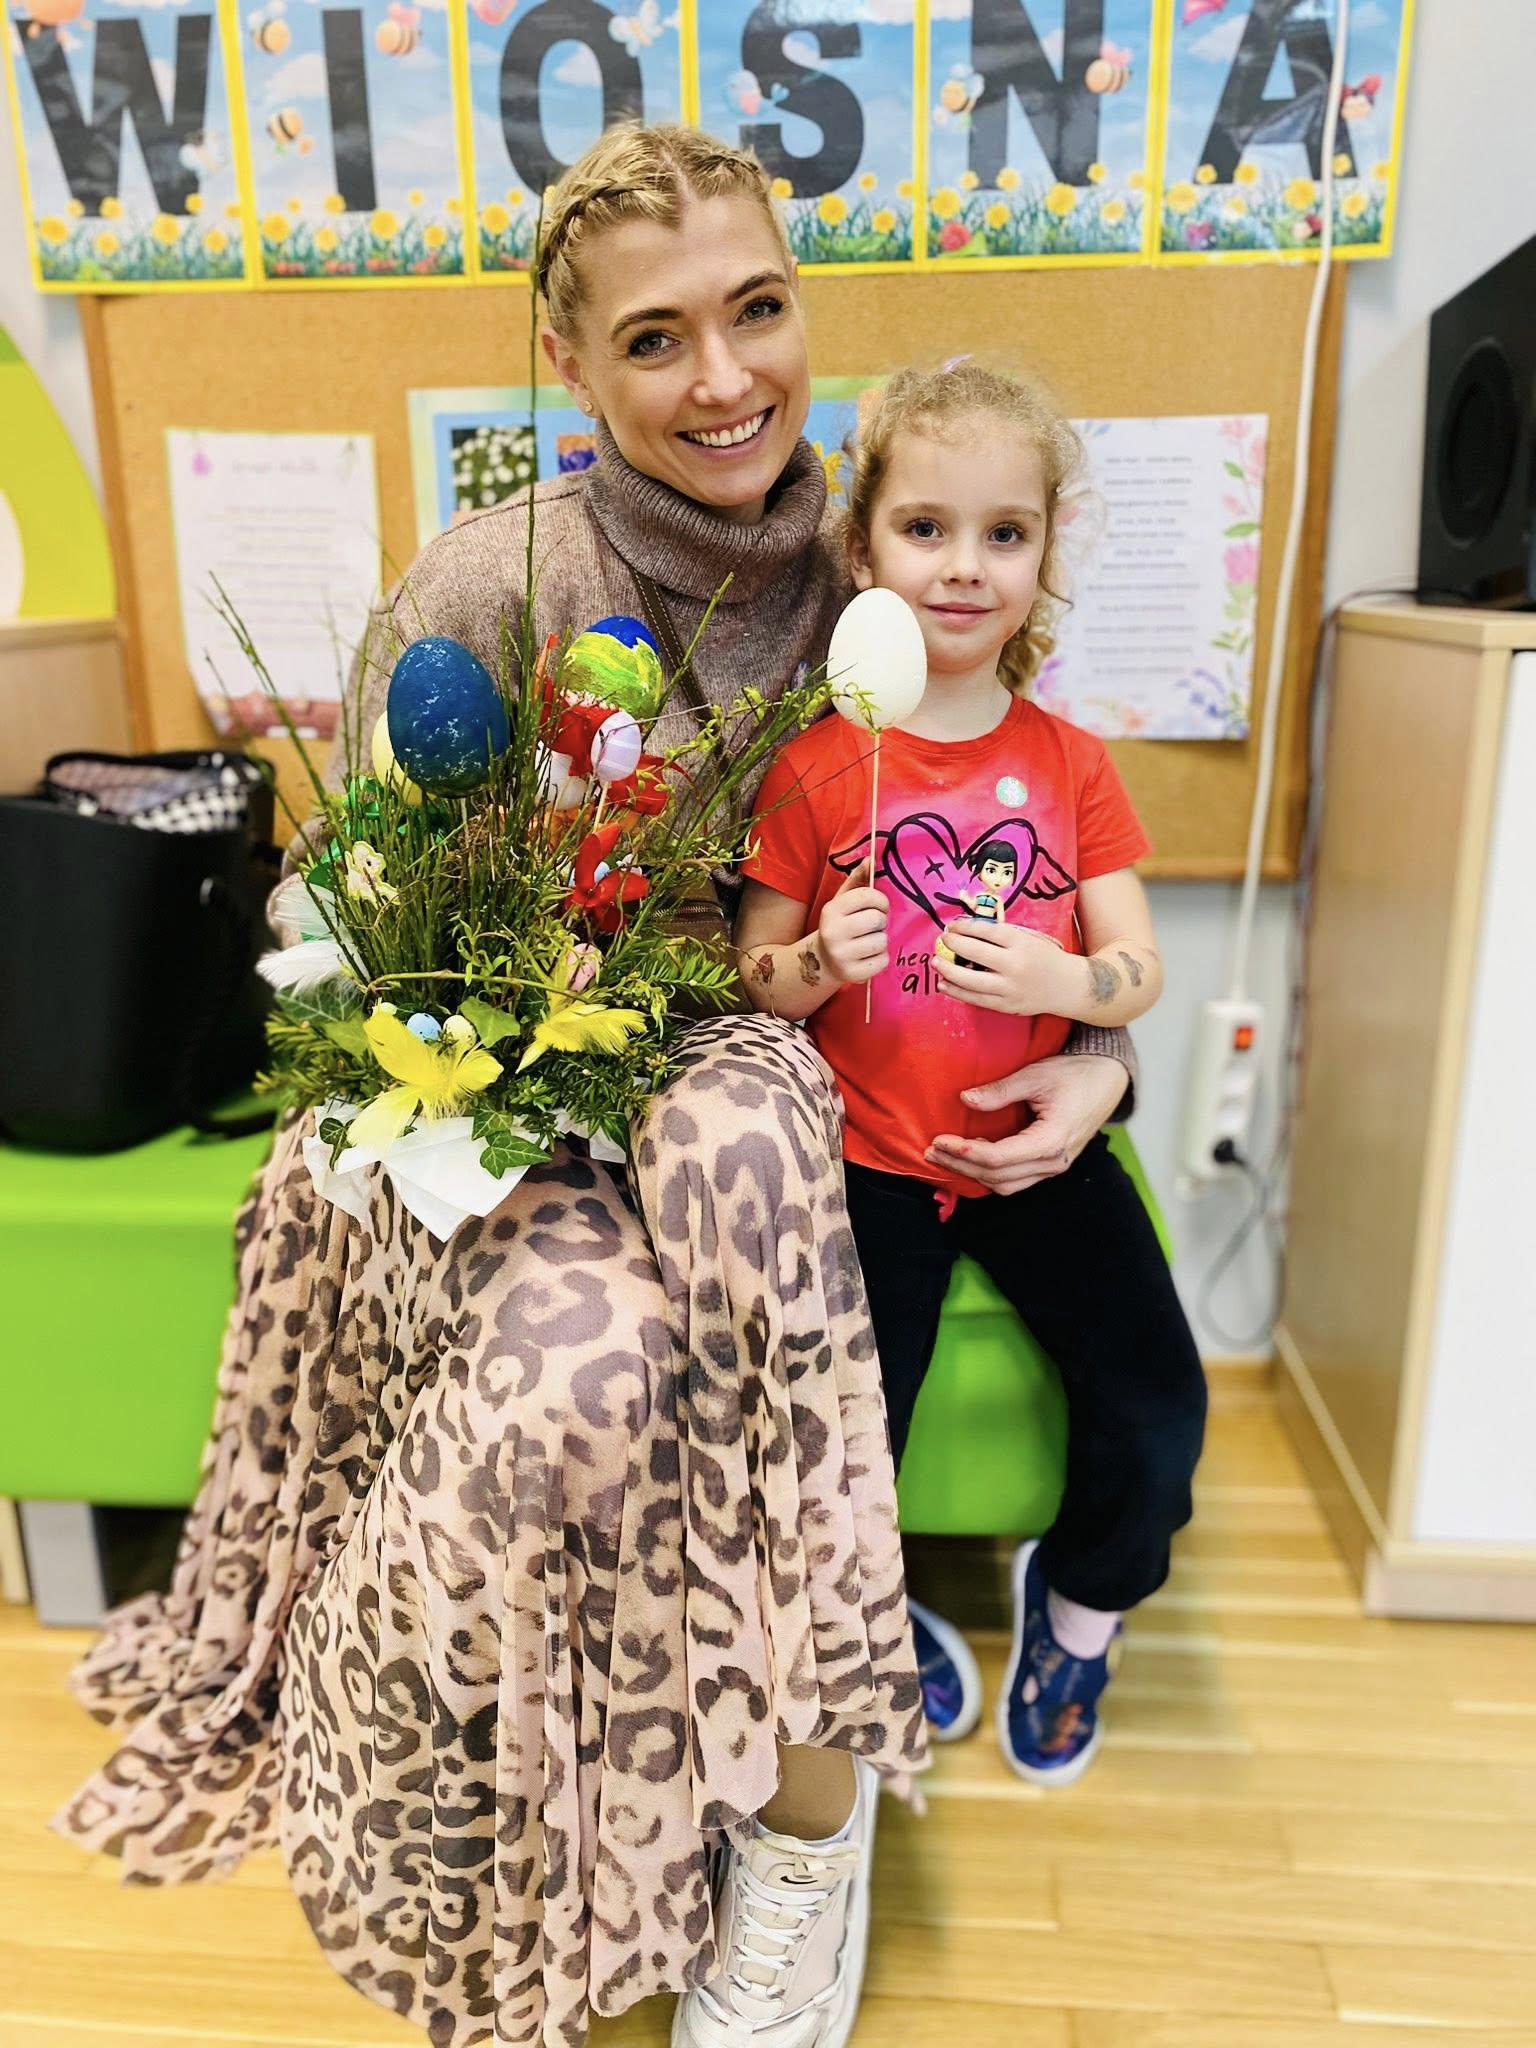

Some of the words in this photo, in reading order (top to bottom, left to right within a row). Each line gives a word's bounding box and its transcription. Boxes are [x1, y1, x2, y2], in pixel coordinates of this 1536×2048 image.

[14, 0, 1359, 217] WIOSNA
[896, 946, 936, 967] hea
[902, 963, 941, 995] ali
